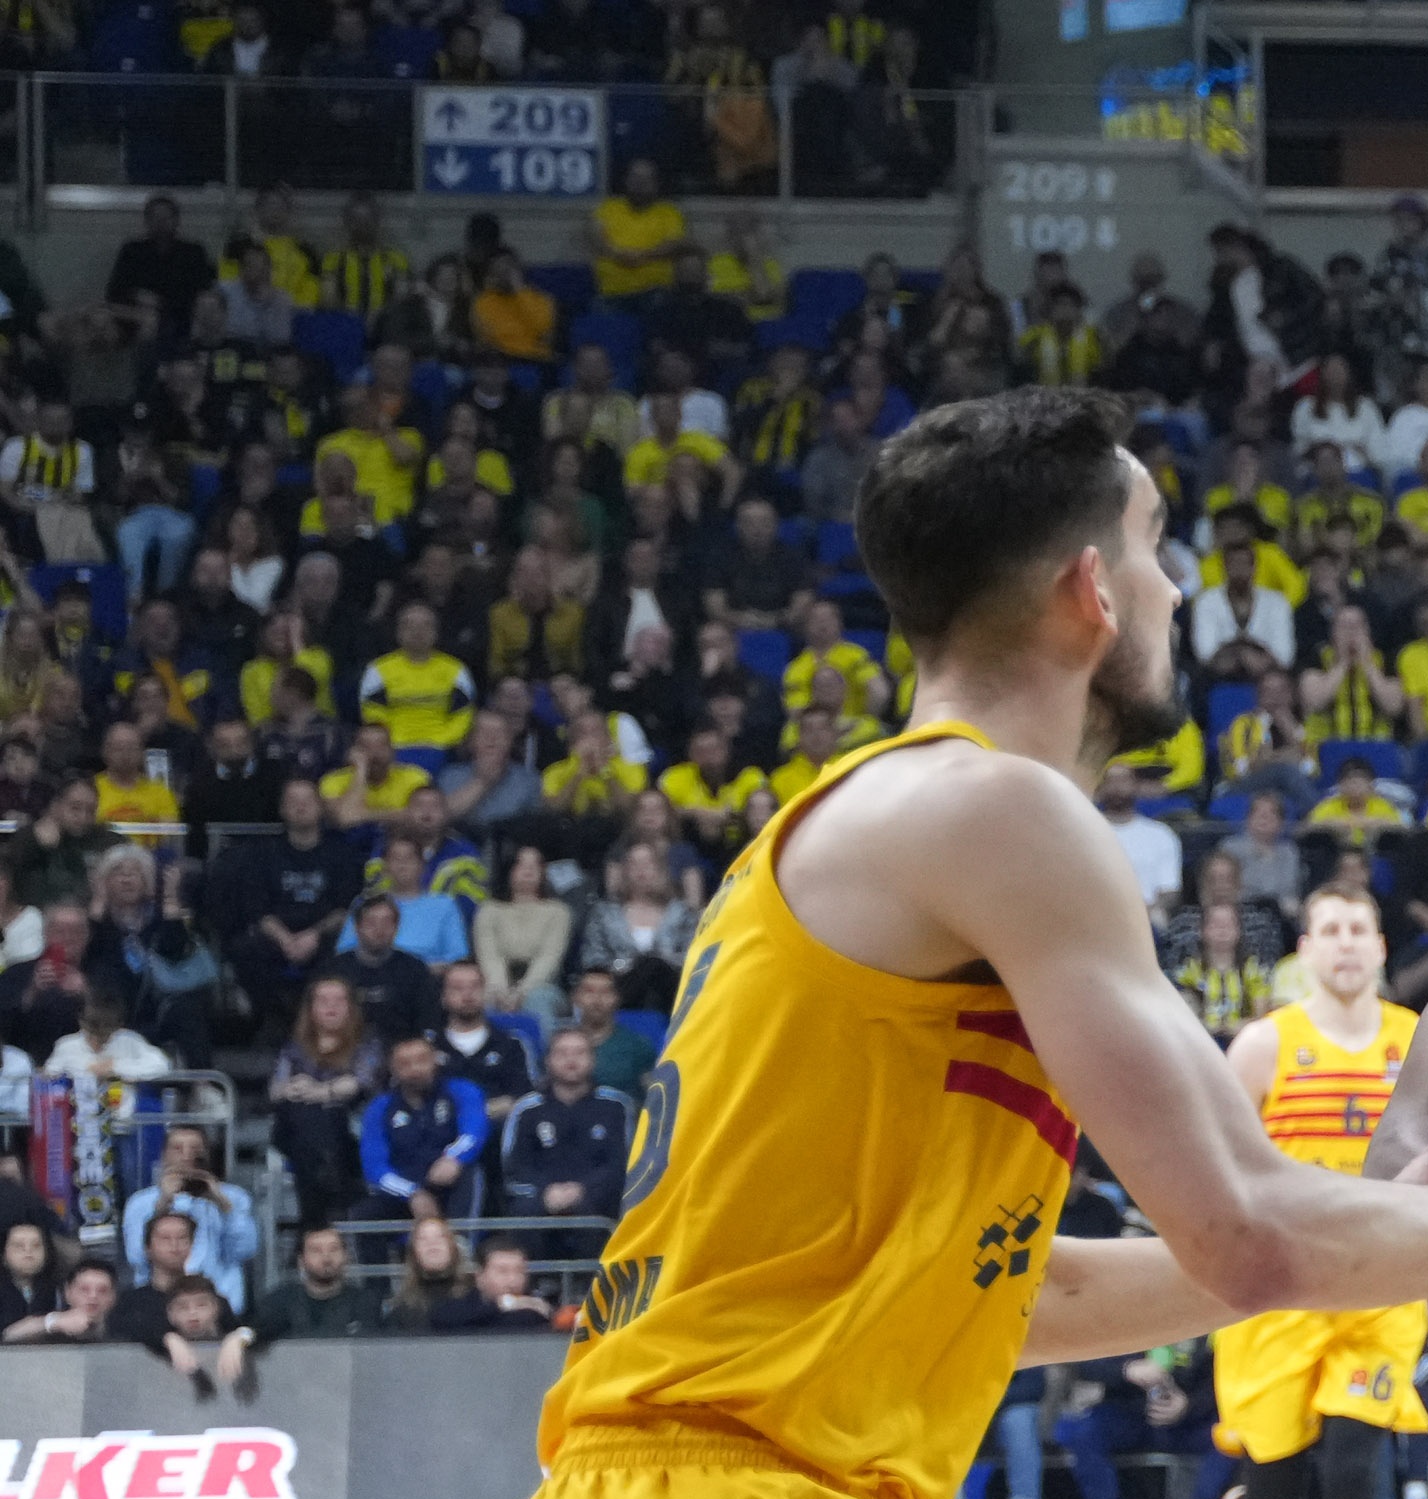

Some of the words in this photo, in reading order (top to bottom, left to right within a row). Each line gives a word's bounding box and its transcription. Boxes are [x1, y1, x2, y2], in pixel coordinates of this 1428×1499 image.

[487, 95, 591, 136] 209
[489, 150, 594, 192] 109
[1343, 1093, 1368, 1137] 6
[1373, 1364, 1392, 1401] 6
